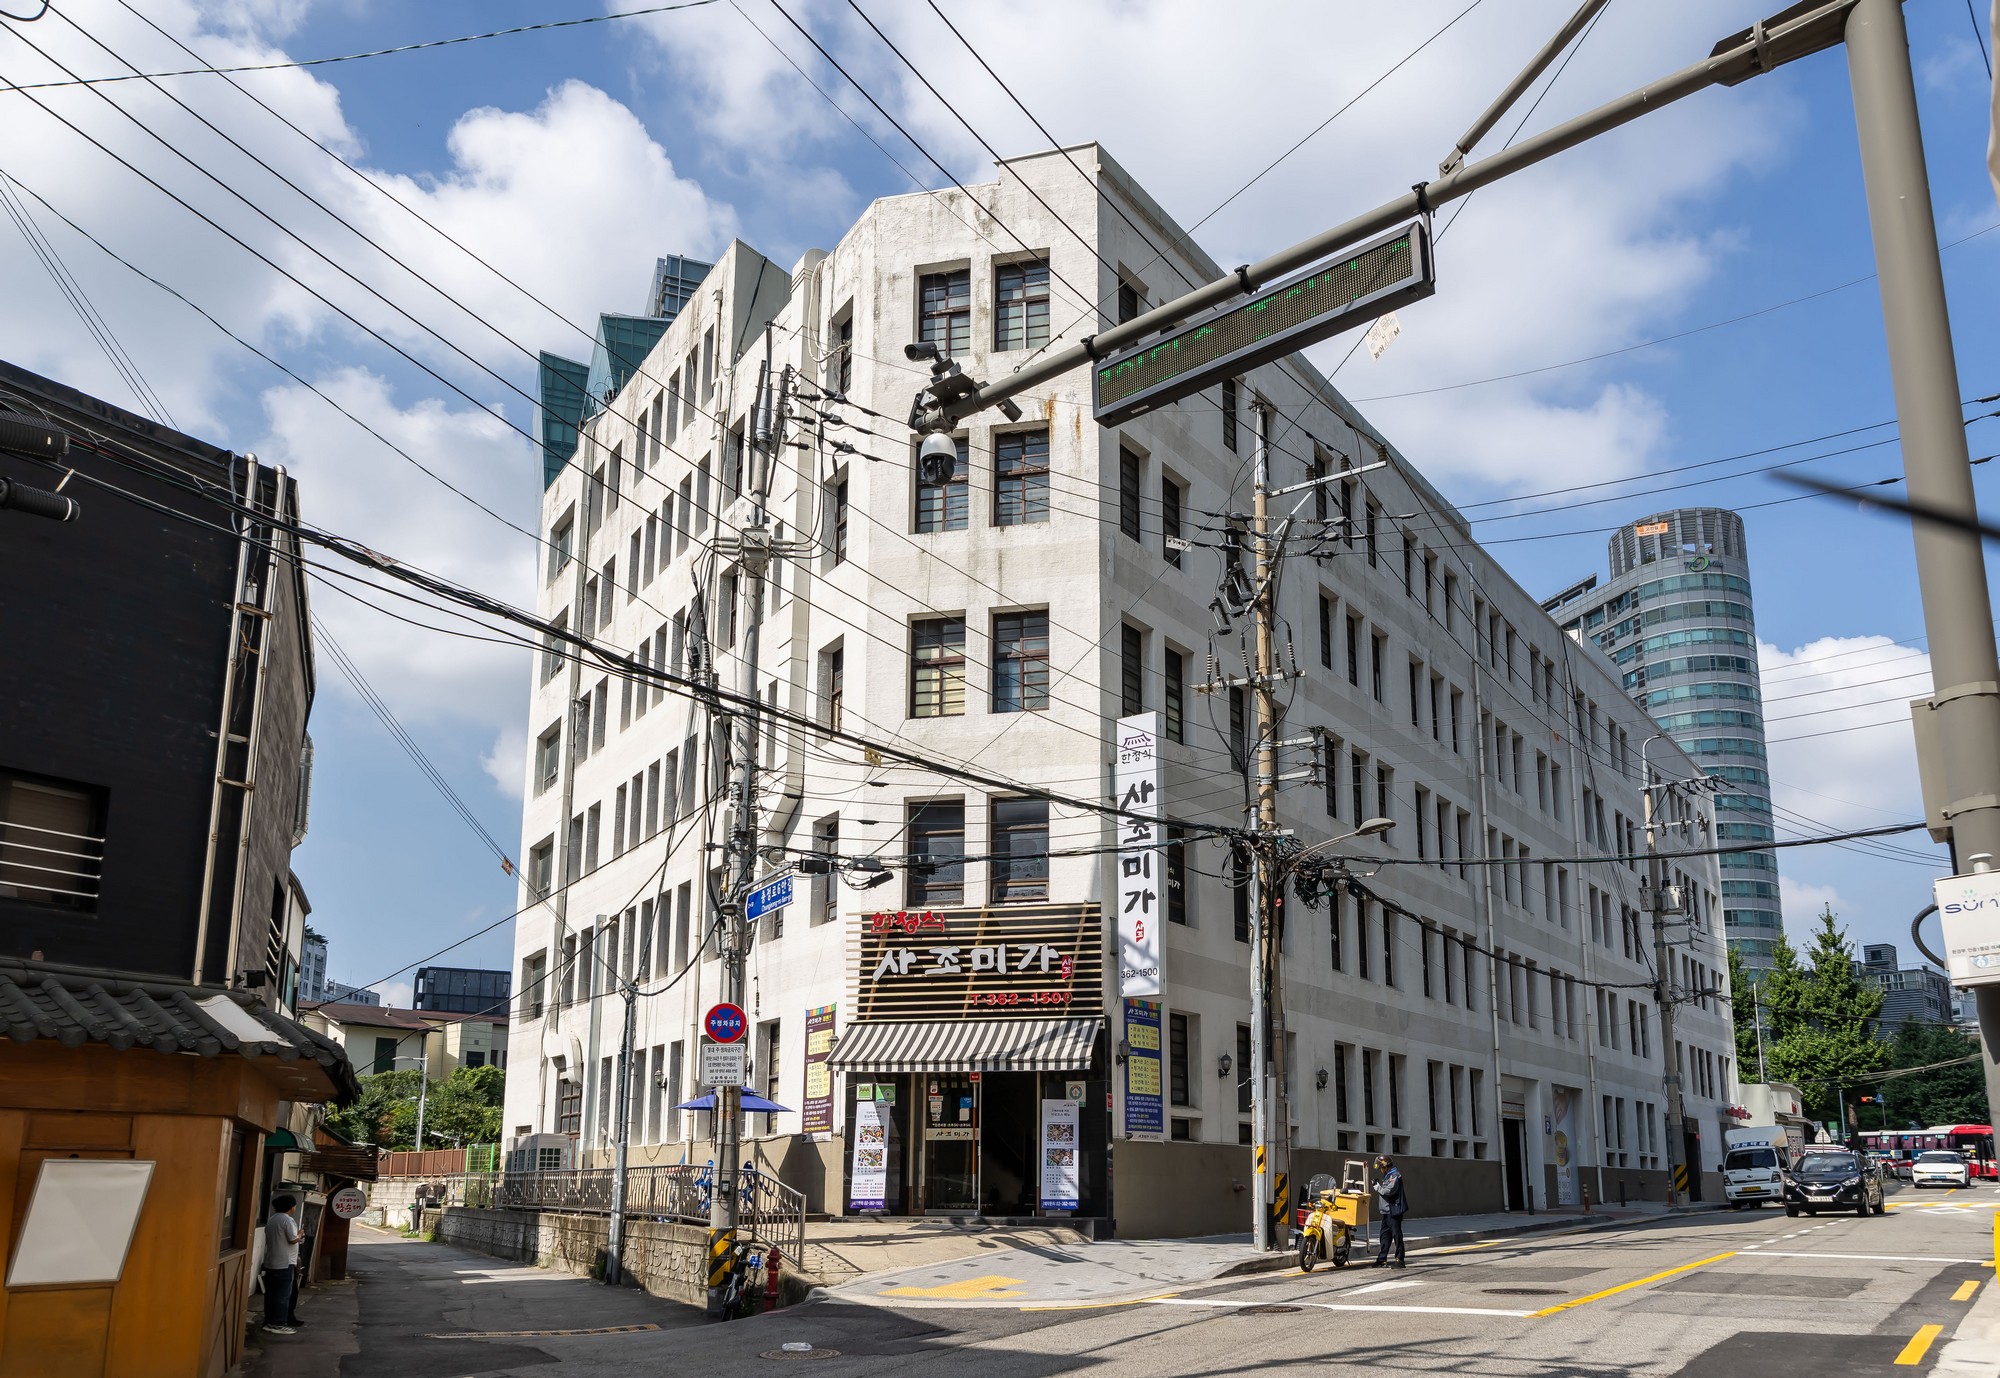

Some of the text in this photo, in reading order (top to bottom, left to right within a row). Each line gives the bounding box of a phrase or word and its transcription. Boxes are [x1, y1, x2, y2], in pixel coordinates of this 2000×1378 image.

[1121, 749, 1151, 764] 한정식
[1120, 780, 1156, 914] 사조미가
[870, 911, 945, 934] 한정식
[872, 943, 1060, 982] 사조미가
[1120, 967, 1158, 979] 362-1500
[1128, 1008, 1148, 1017] 사조미가
[710, 1019, 741, 1027] 주정차금지
